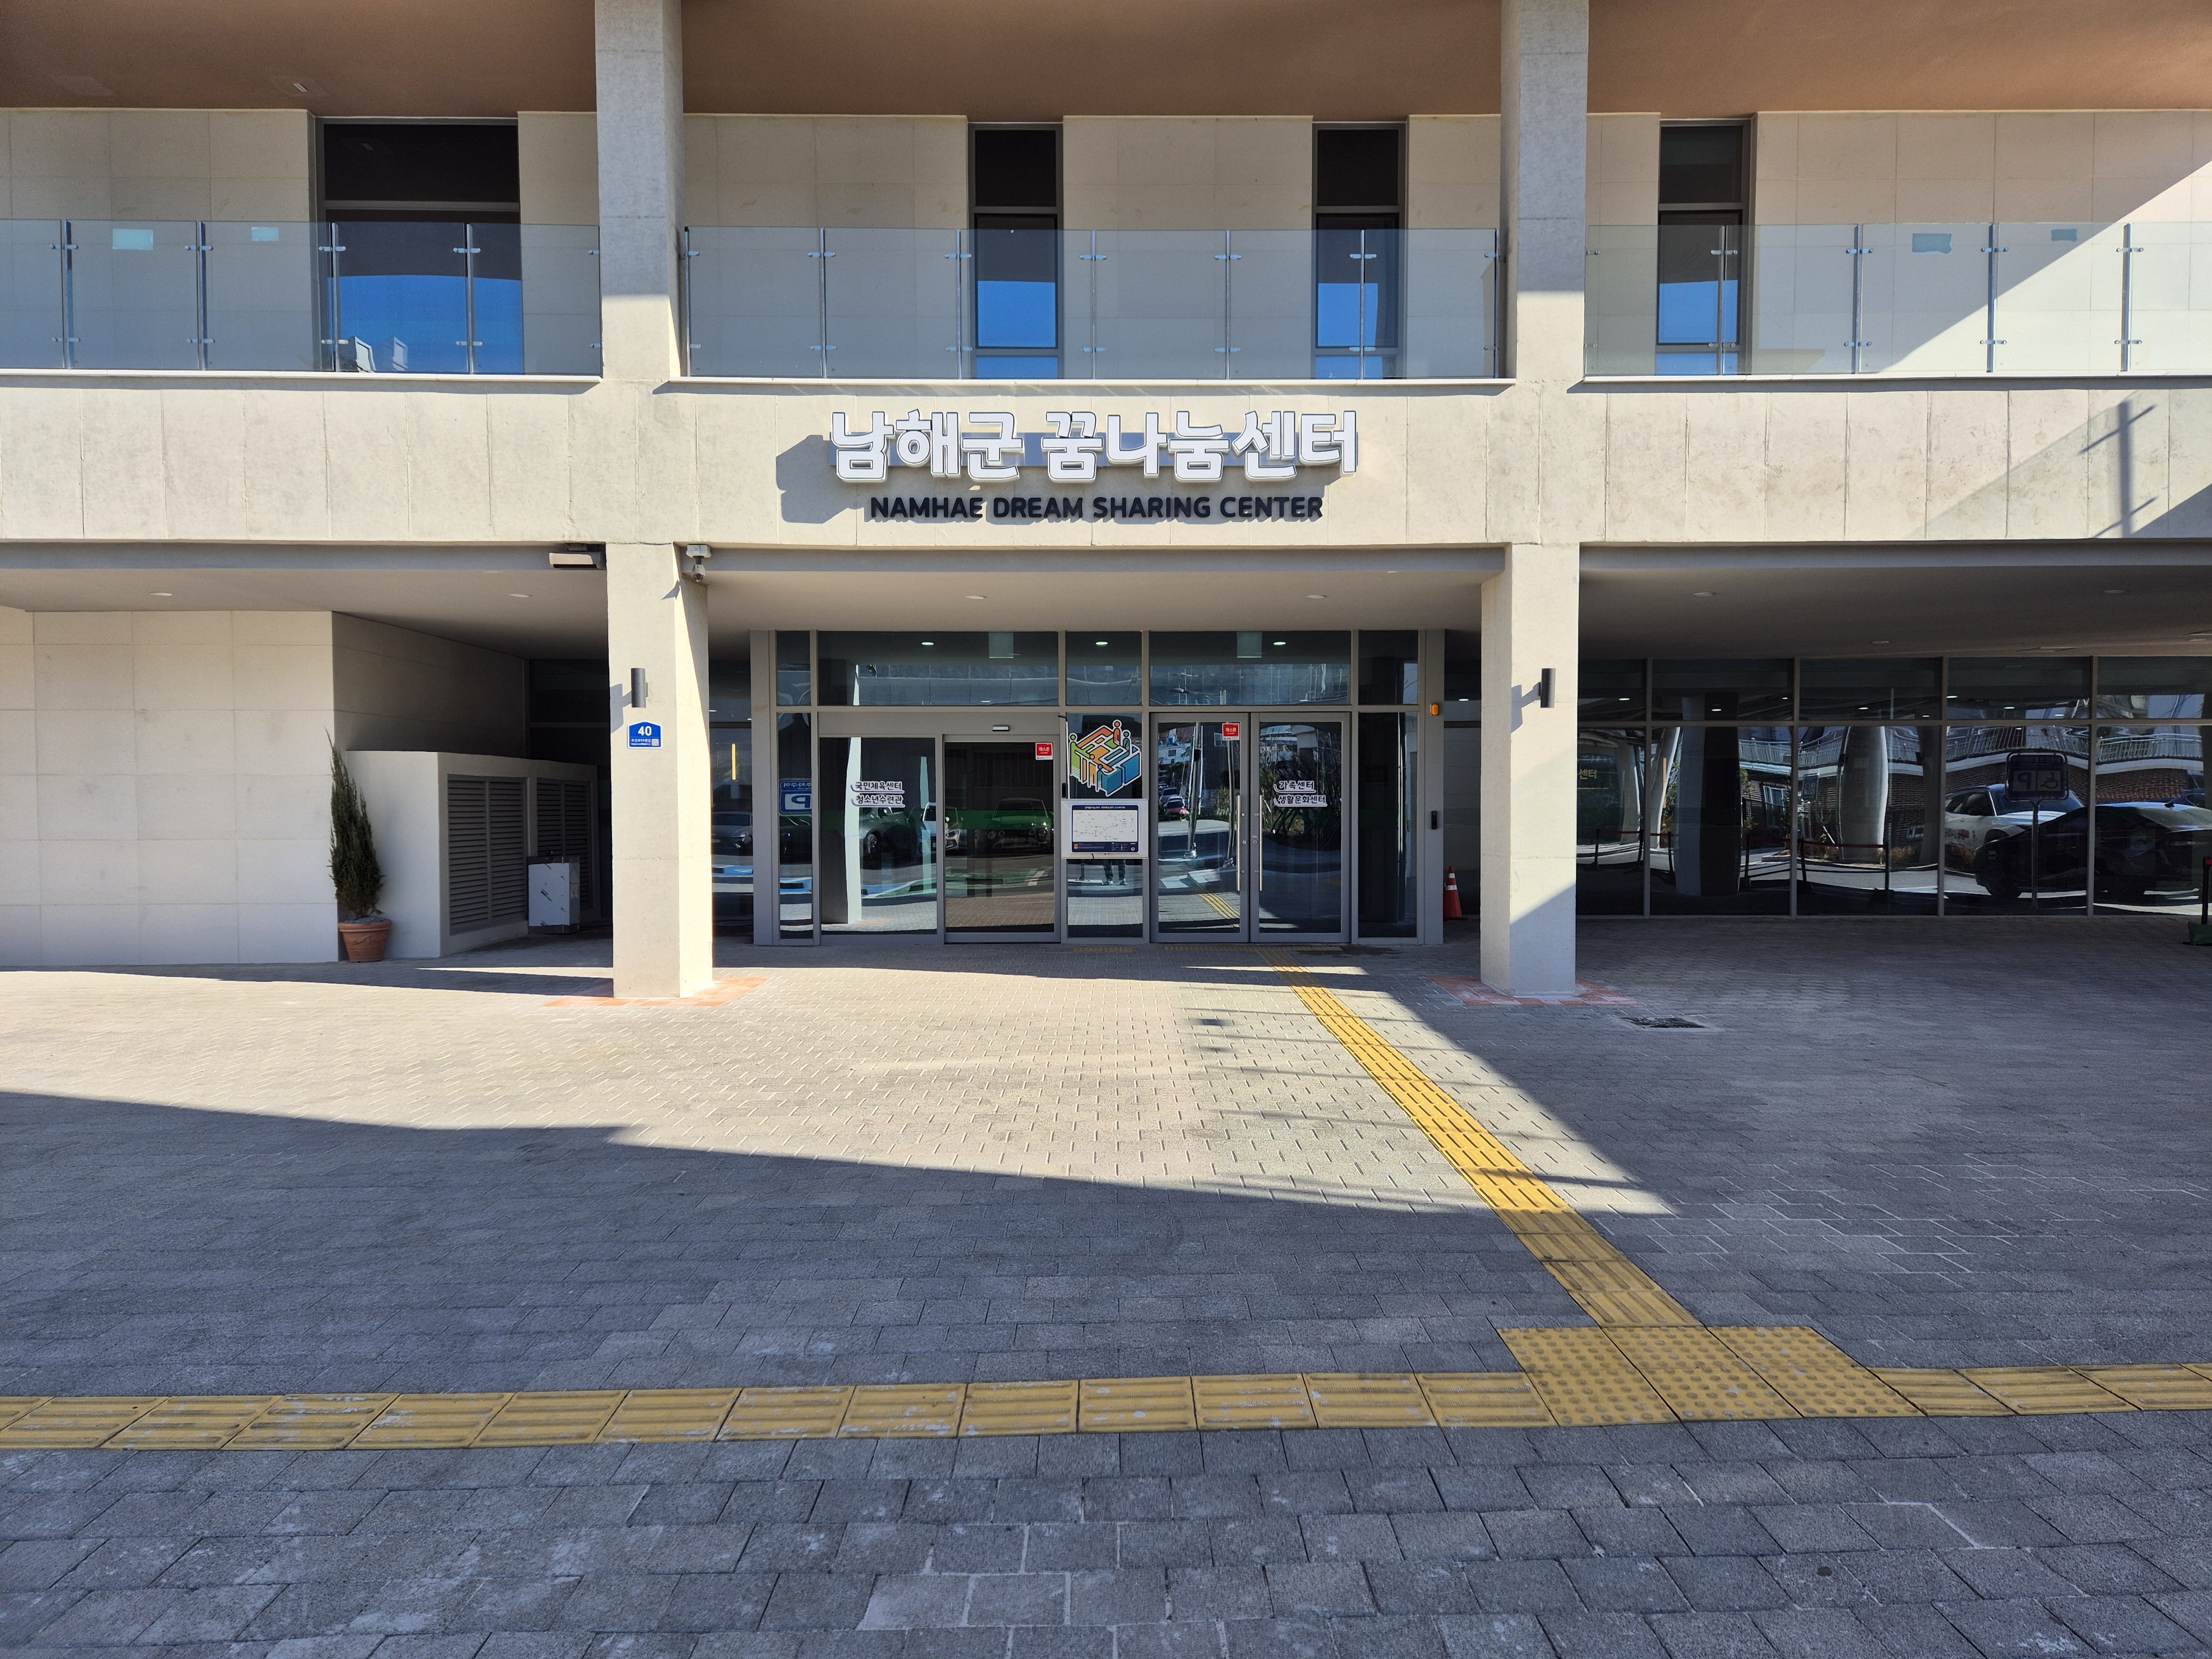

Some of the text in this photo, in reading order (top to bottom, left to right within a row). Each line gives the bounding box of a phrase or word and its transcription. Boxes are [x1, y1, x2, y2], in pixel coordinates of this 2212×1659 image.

[831, 409, 1358, 483] 남해군 꿈나눔센터
[870, 497, 1323, 519] NAMHAE DREAM SHARING CENTER
[638, 726, 652, 736] 40
[1578, 769, 1597, 780] 센터
[855, 781, 901, 790] 국민체육센터
[1279, 781, 1313, 790] 가족센터
[856, 795, 902, 804] 청소년수련관
[1279, 795, 1325, 804] 생활문화센터
